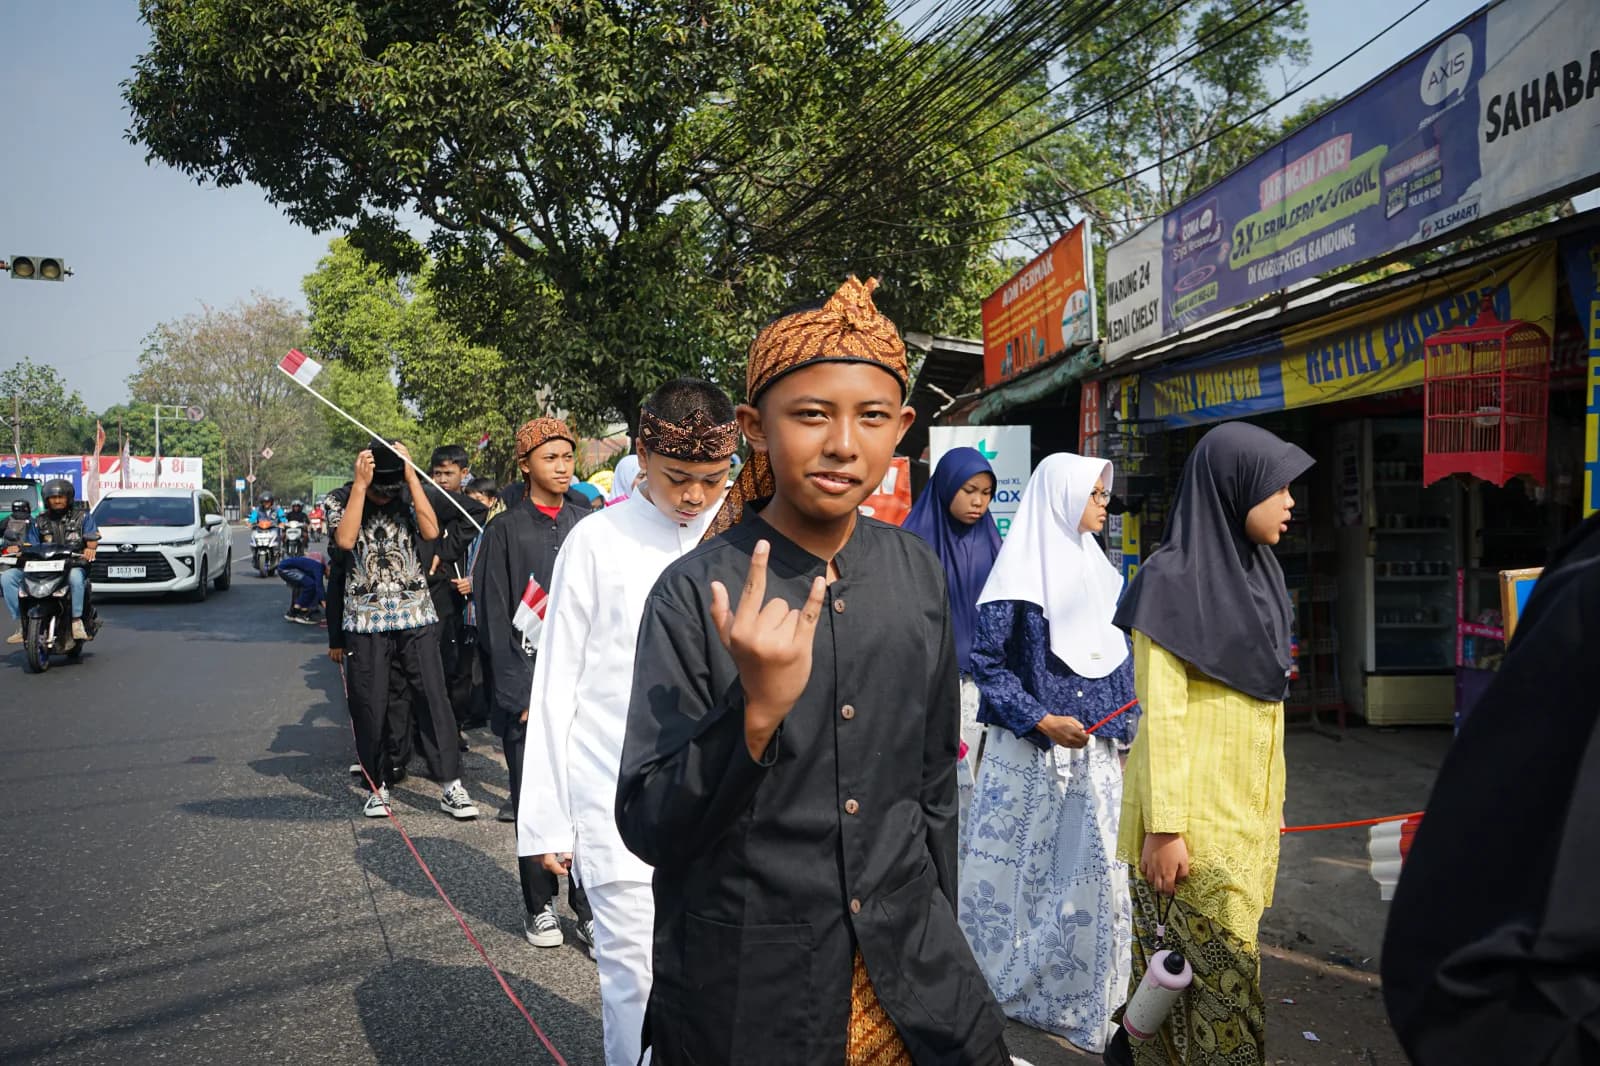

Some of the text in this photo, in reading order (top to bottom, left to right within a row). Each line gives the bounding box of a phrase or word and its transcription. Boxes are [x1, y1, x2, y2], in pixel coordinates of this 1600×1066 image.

[1427, 52, 1465, 91] AXIS
[1317, 137, 1346, 176] AXIS
[1433, 202, 1479, 233] XLSMART
[1019, 252, 1055, 292] PERMAK
[1257, 244, 1307, 283] KABUPATEN
[1308, 223, 1356, 262] BANDUNG
[1107, 269, 1138, 307] WARUNG
[1139, 260, 1151, 290] 24
[1107, 314, 1130, 344] KEDAI
[1131, 297, 1159, 334] CHELSY
[1305, 327, 1383, 385] REFILL
[1195, 364, 1262, 410] PARFUM
